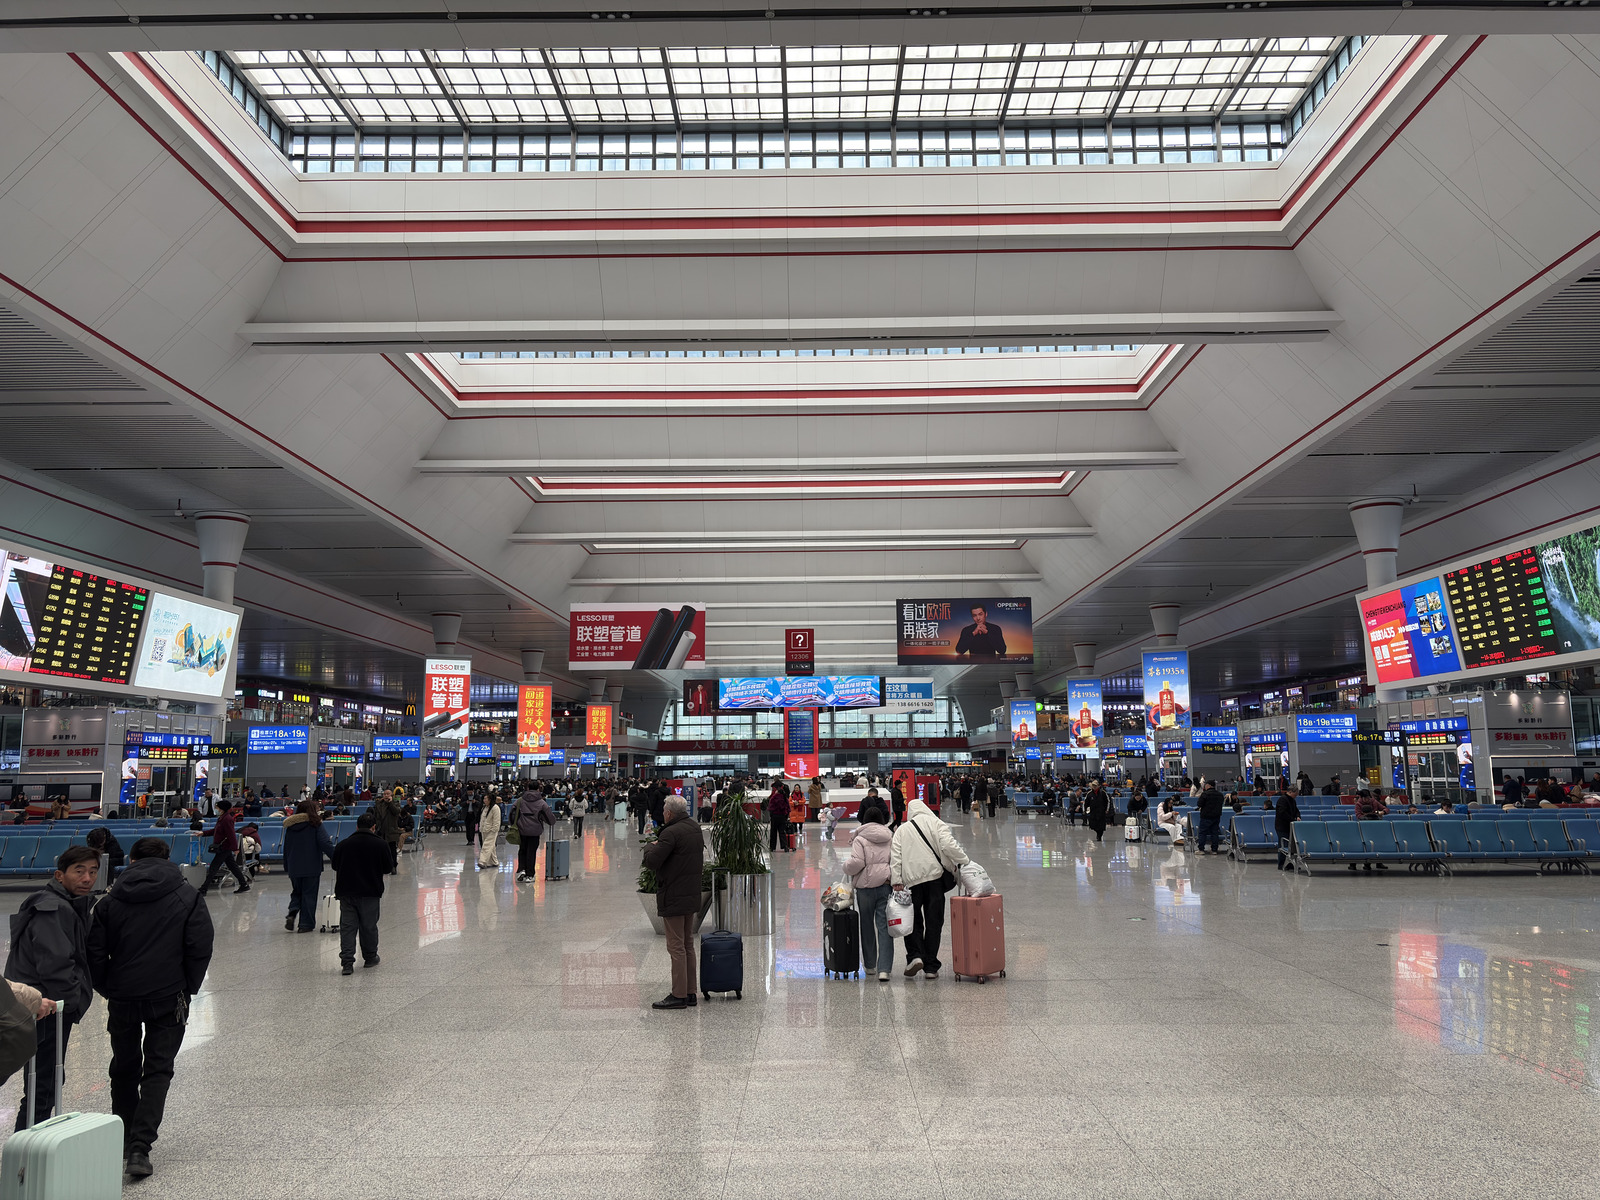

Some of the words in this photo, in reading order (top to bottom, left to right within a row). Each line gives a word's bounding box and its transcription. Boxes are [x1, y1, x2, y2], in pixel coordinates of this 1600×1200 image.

[903, 602, 952, 620] 看过欧派
[576, 626, 642, 642] 联塑管道
[903, 622, 939, 639] 再装家
[432, 677, 464, 692] 联塑
[431, 693, 463, 708] 管道
[525, 691, 535, 725] 回家过年
[692, 740, 757, 749] 人民有信仰
[867, 739, 930, 747] 民族有希望
[28, 748, 60, 757] 多彩服务
